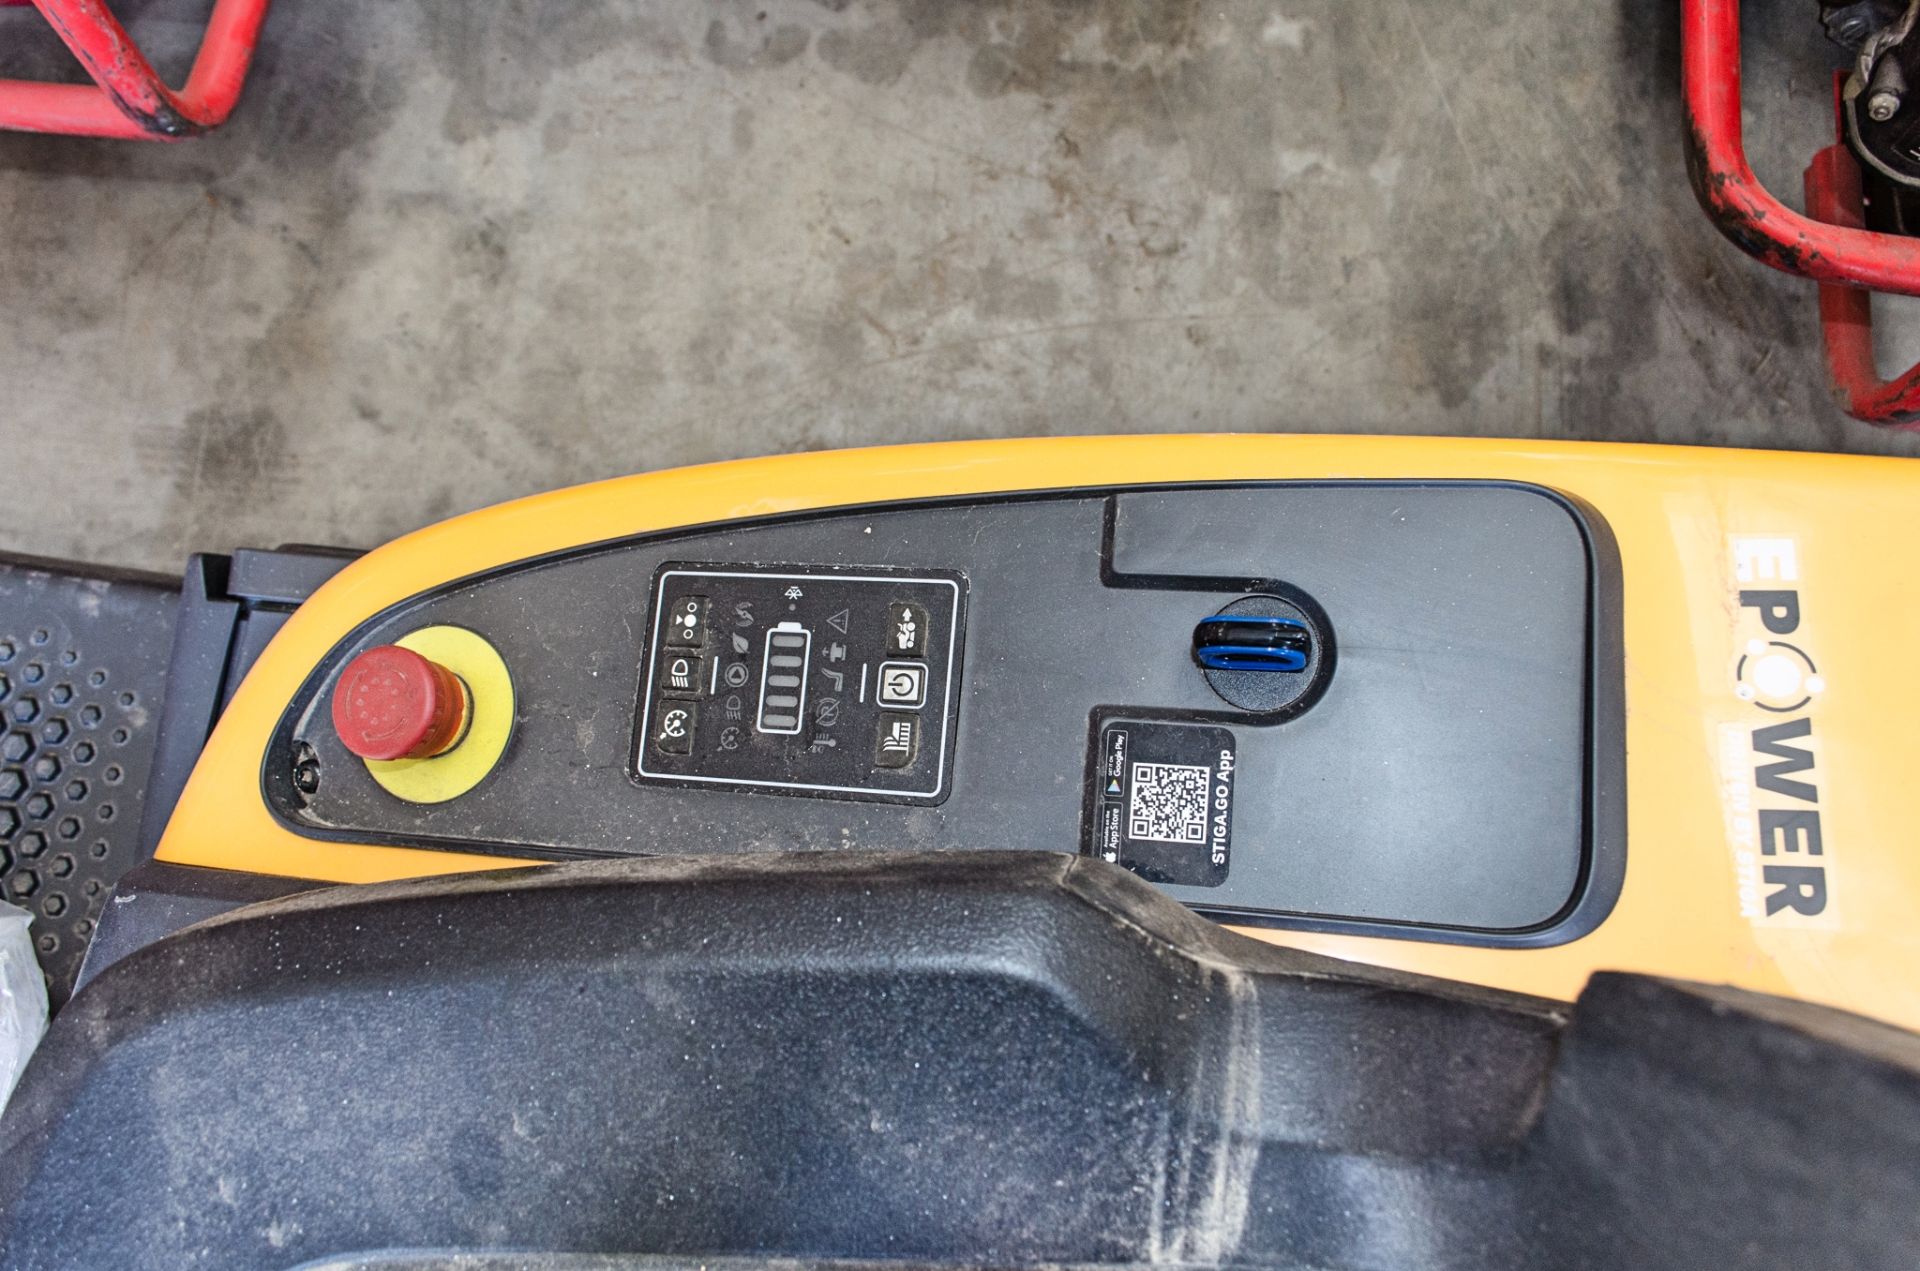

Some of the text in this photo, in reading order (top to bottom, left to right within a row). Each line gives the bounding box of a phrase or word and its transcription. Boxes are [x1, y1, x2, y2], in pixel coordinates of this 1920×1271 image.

[1113, 734, 1125, 777] Google Play
[1734, 538, 1828, 917] EPOWER
[1108, 808, 1120, 849] App Store
[1211, 749, 1234, 864] STIGA.GO App
